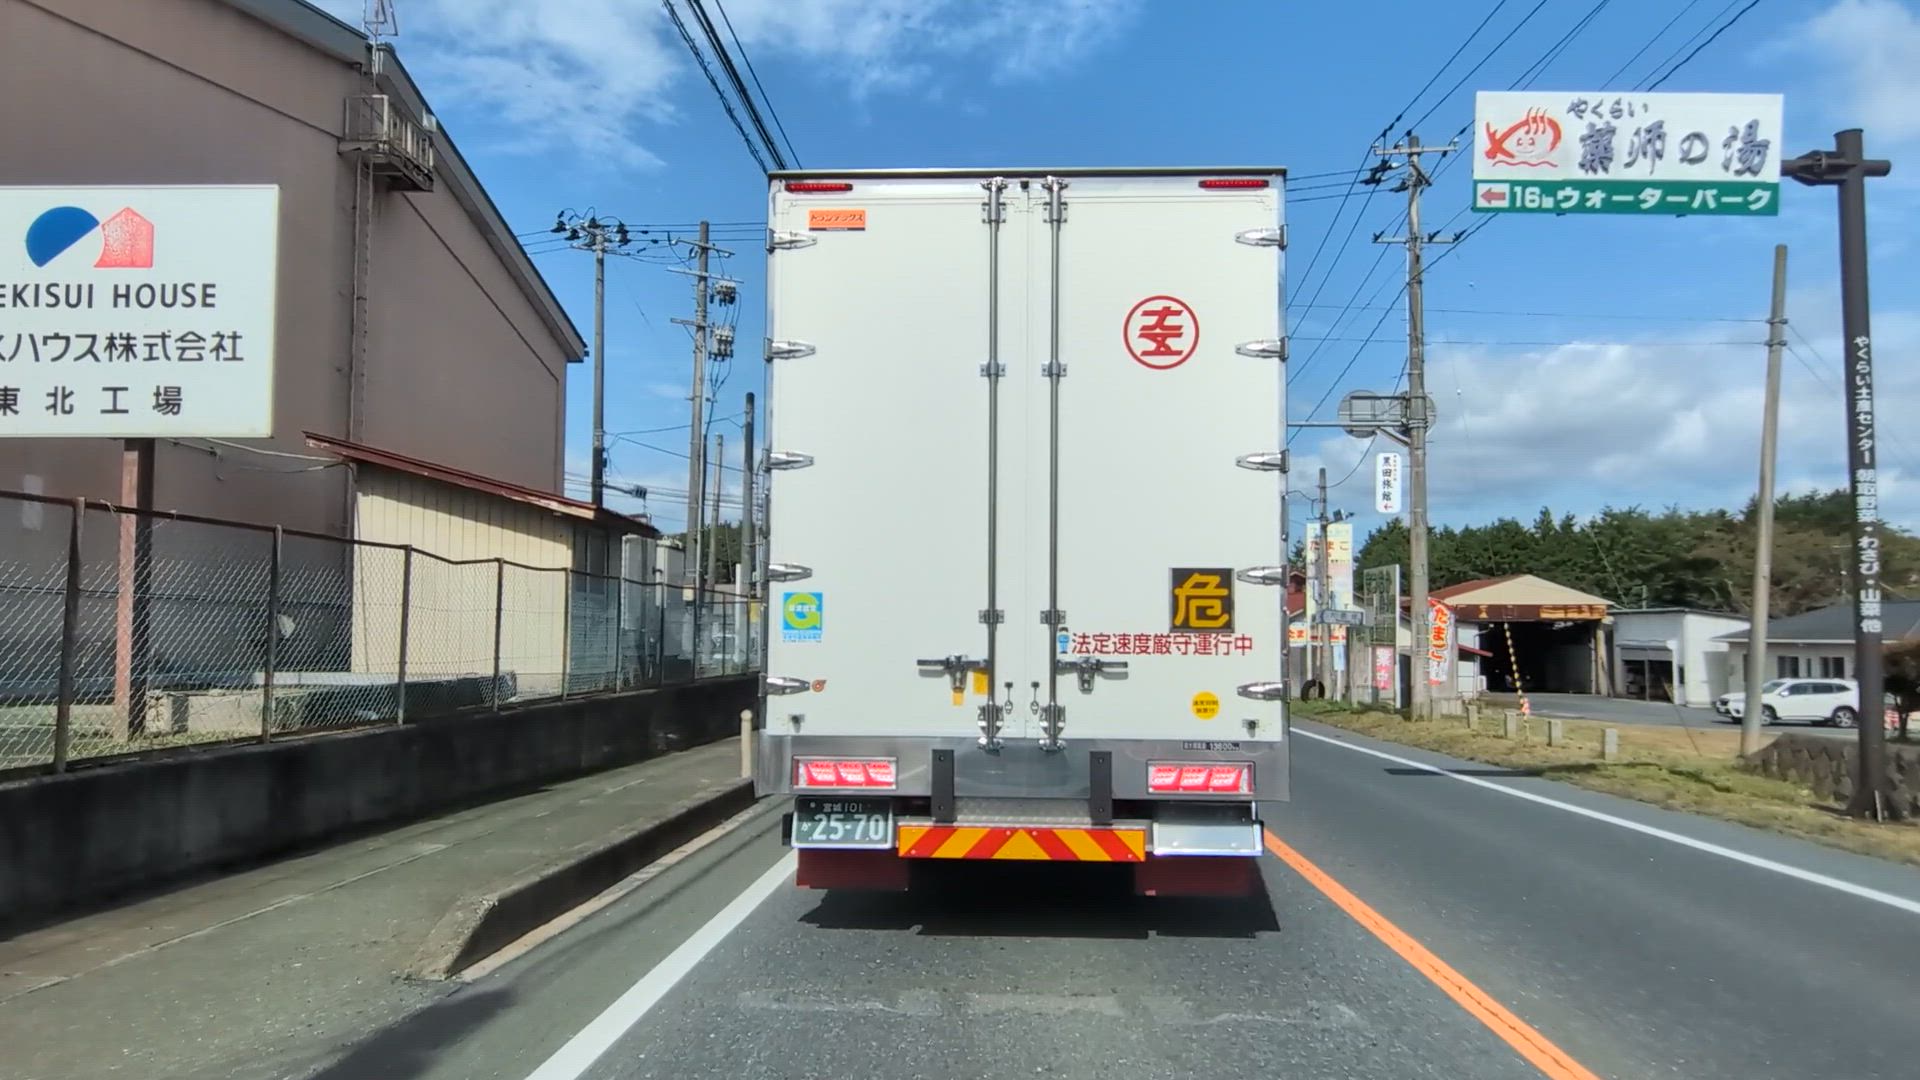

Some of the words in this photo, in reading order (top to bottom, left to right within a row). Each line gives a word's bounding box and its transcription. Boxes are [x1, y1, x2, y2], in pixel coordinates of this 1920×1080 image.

[1566, 97, 1649, 119] やくらい
[1578, 119, 1771, 177] 薬師の湯
[112, 283, 216, 309] HOUSE
[1174, 573, 1229, 628] 危
[1072, 632, 1253, 656] 法定速度厳守運行中
[812, 814, 884, 841] 25-70
